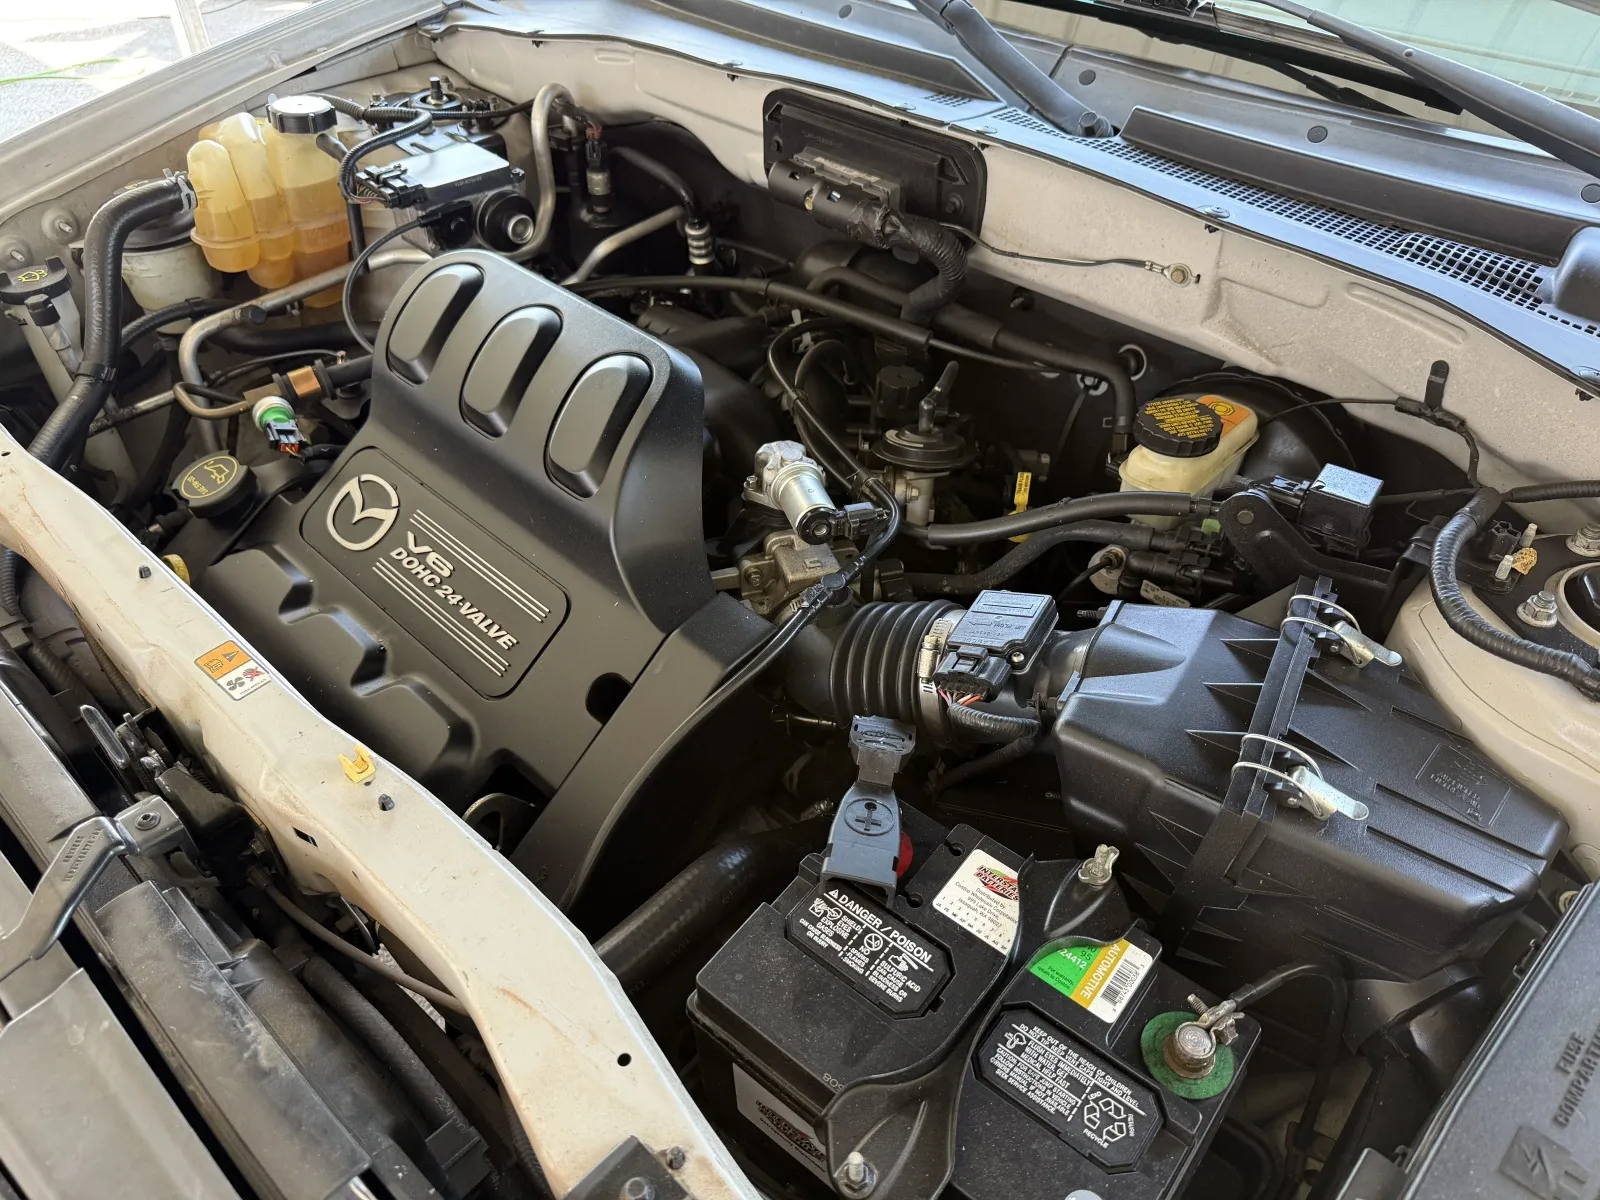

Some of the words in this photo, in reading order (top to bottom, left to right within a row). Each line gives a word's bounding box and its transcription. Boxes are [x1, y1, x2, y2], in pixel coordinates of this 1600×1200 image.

[407, 531, 455, 578] V6
[390, 547, 441, 588] DOHC
[435, 585, 518, 650] 24-VALVE
[974, 869, 1020, 903] BATTERIES
[977, 864, 1020, 896] INTERSTA
[820, 915, 849, 939] EXPLOSIVE
[836, 919, 852, 933] EYES
[837, 892, 883, 928] DANGER
[889, 928, 932, 963] POISON
[840, 914, 861, 932] SHIELD
[978, 910, 988, 919] WA
[815, 921, 835, 937] GASES
[845, 951, 865, 968] FLAMES
[849, 946, 870, 964] SPARKS
[858, 944, 871, 956] NO
[1056, 945, 1087, 969] 24412
[1079, 949, 1093, 961] 95
[867, 974, 887, 991] SEVERE
[871, 970, 899, 992] BLINDNESS
[898, 989, 908, 998] OR
[875, 965, 887, 976] CAN
[885, 972, 904, 988] CAUSE
[879, 959, 908, 983] SULFURIC
[905, 978, 921, 992] ACID
[1079, 942, 1122, 1000] AUTOMOTIVE
[1018, 1023, 1029, 1032] DO
[1027, 1029, 1041, 1041] NOT
[1049, 1044, 1065, 1057] KEEP
[1063, 1054, 1079, 1067] VENT
[1077, 1063, 1094, 1077] CAPS
[1093, 1074, 1111, 1089] TIGHT
[1109, 1085, 1123, 1097] AND
[1121, 1094, 1140, 1109] LEVEL
[1023, 1046, 1039, 1059] WITH
[1055, 1068, 1068, 1079] GET
[1027, 1039, 1045, 1055] FLUSH
[1043, 1051, 1059, 1064] EYES
[1057, 1060, 1091, 1086] IMMEDIATELY
[1032, 1025, 1048, 1039] KEEP
[1046, 1034, 1059, 1046] OUT
[1058, 1042, 1067, 1052] OF
[1066, 1048, 1079, 1060] THE
[1077, 1056, 1096, 1072] REACH
[1095, 1068, 1105, 1077] OF
[1103, 1074, 1132, 1096] CHILDREN
[1554, 1032, 1586, 1077] FUSE
[993, 1052, 1013, 1069] FOLLOW
[1045, 1088, 1053, 1096] IN
[1016, 1061, 1029, 1072] FOR
[1027, 1068, 1040, 1080] SAFE
[1052, 1085, 1077, 1105] STARTING
[1019, 1051, 1043, 1070] MEDICAL
[1041, 1067, 1056, 1080] HELP
[1054, 1076, 1070, 1089] FAST
[1033, 1088, 1047, 1099] NOT
[1087, 1091, 1102, 1101] LEAD
[1127, 1113, 1135, 1137] RETURN
[1083, 1128, 1109, 1149] RECYCLE
